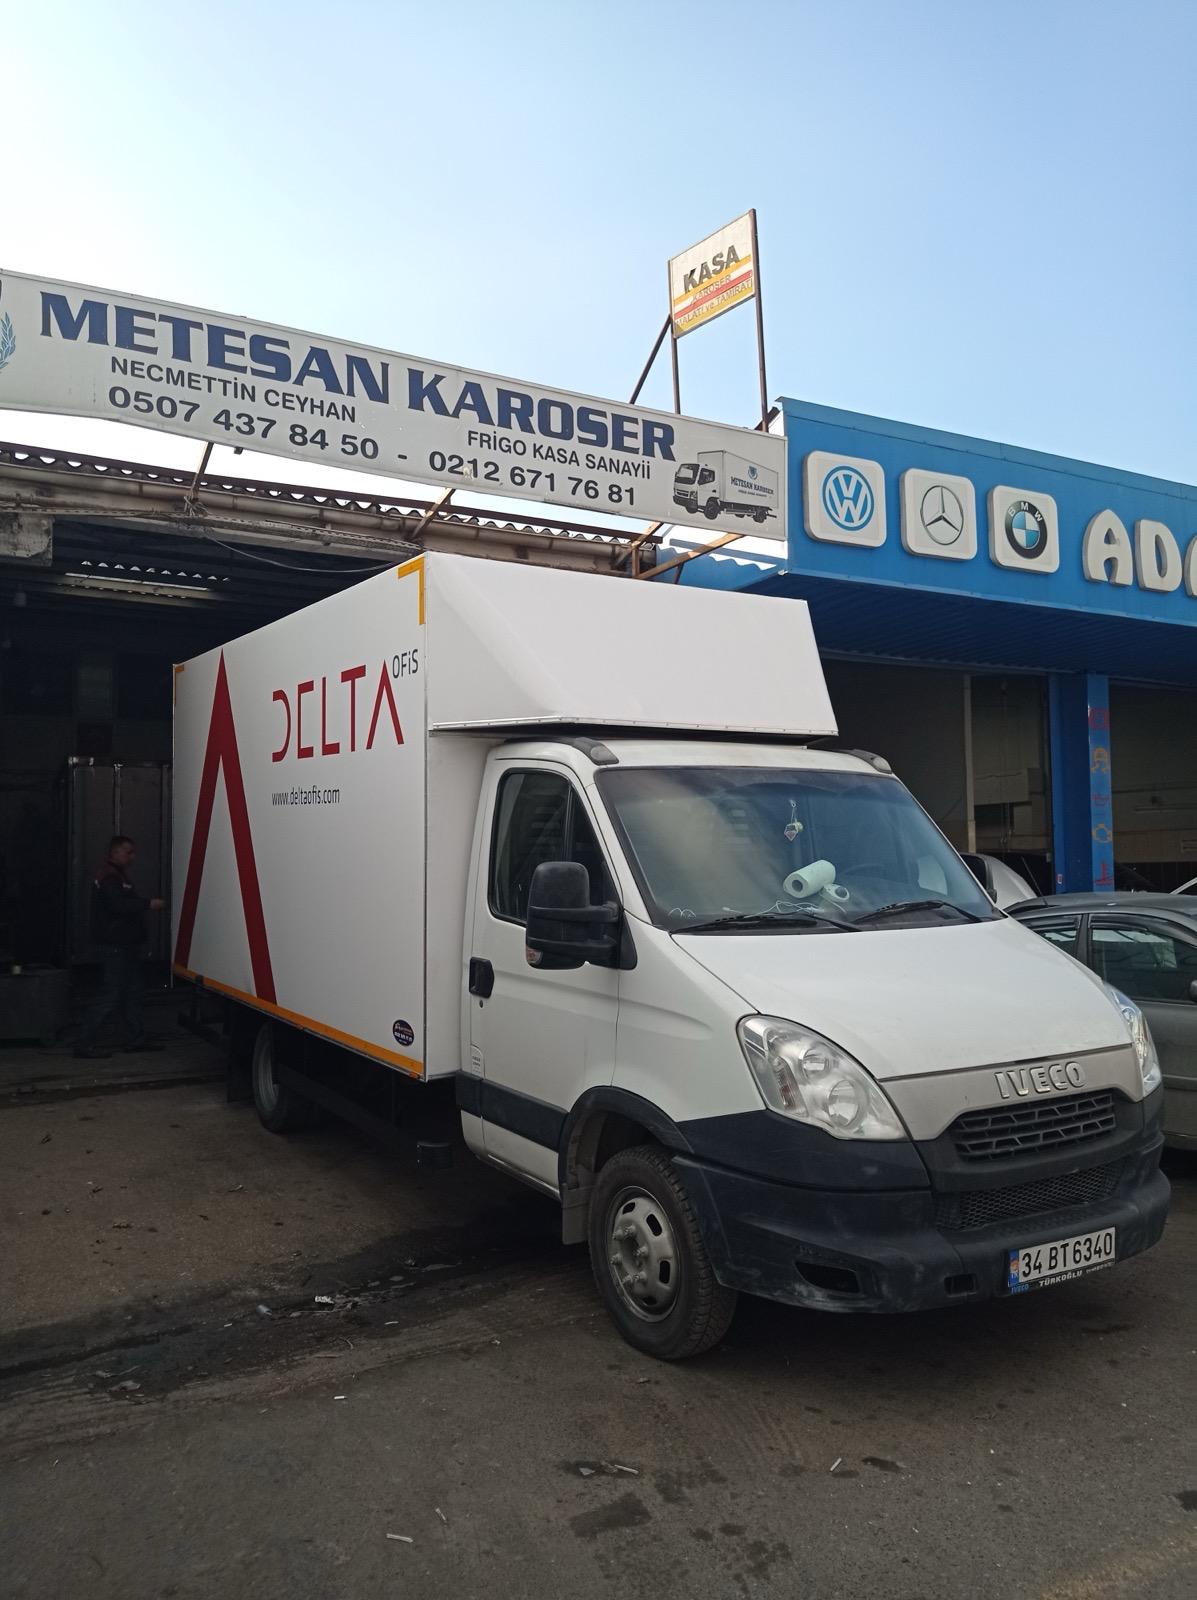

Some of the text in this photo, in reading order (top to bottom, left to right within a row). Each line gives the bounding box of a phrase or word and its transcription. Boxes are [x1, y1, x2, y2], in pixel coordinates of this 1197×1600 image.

[683, 245, 740, 294] KASA
[691, 274, 731, 306] KAROSER
[40, 291, 676, 462] METESAN KAROSER
[264, 388, 356, 423] CEYHAN
[108, 385, 200, 422] 0507
[212, 408, 277, 439] 437
[289, 423, 329, 450] 84
[340, 434, 379, 460] 50
[428, 450, 500, 482] 0212
[510, 466, 556, 492] 671
[567, 476, 599, 499] 76
[607, 484, 635, 505] 81
[533, 443, 580, 465] KASA
[272, 659, 405, 763] DELTA
[271, 785, 340, 806] www.deltaofis.com
[994, 1061, 1087, 1100] IVECO
[1022, 1248, 1043, 1278] 34
[1048, 1242, 1069, 1271] BT
[1072, 1232, 1113, 1265] 6340
[1039, 1270, 1083, 1287] TÜRKOĞLU
